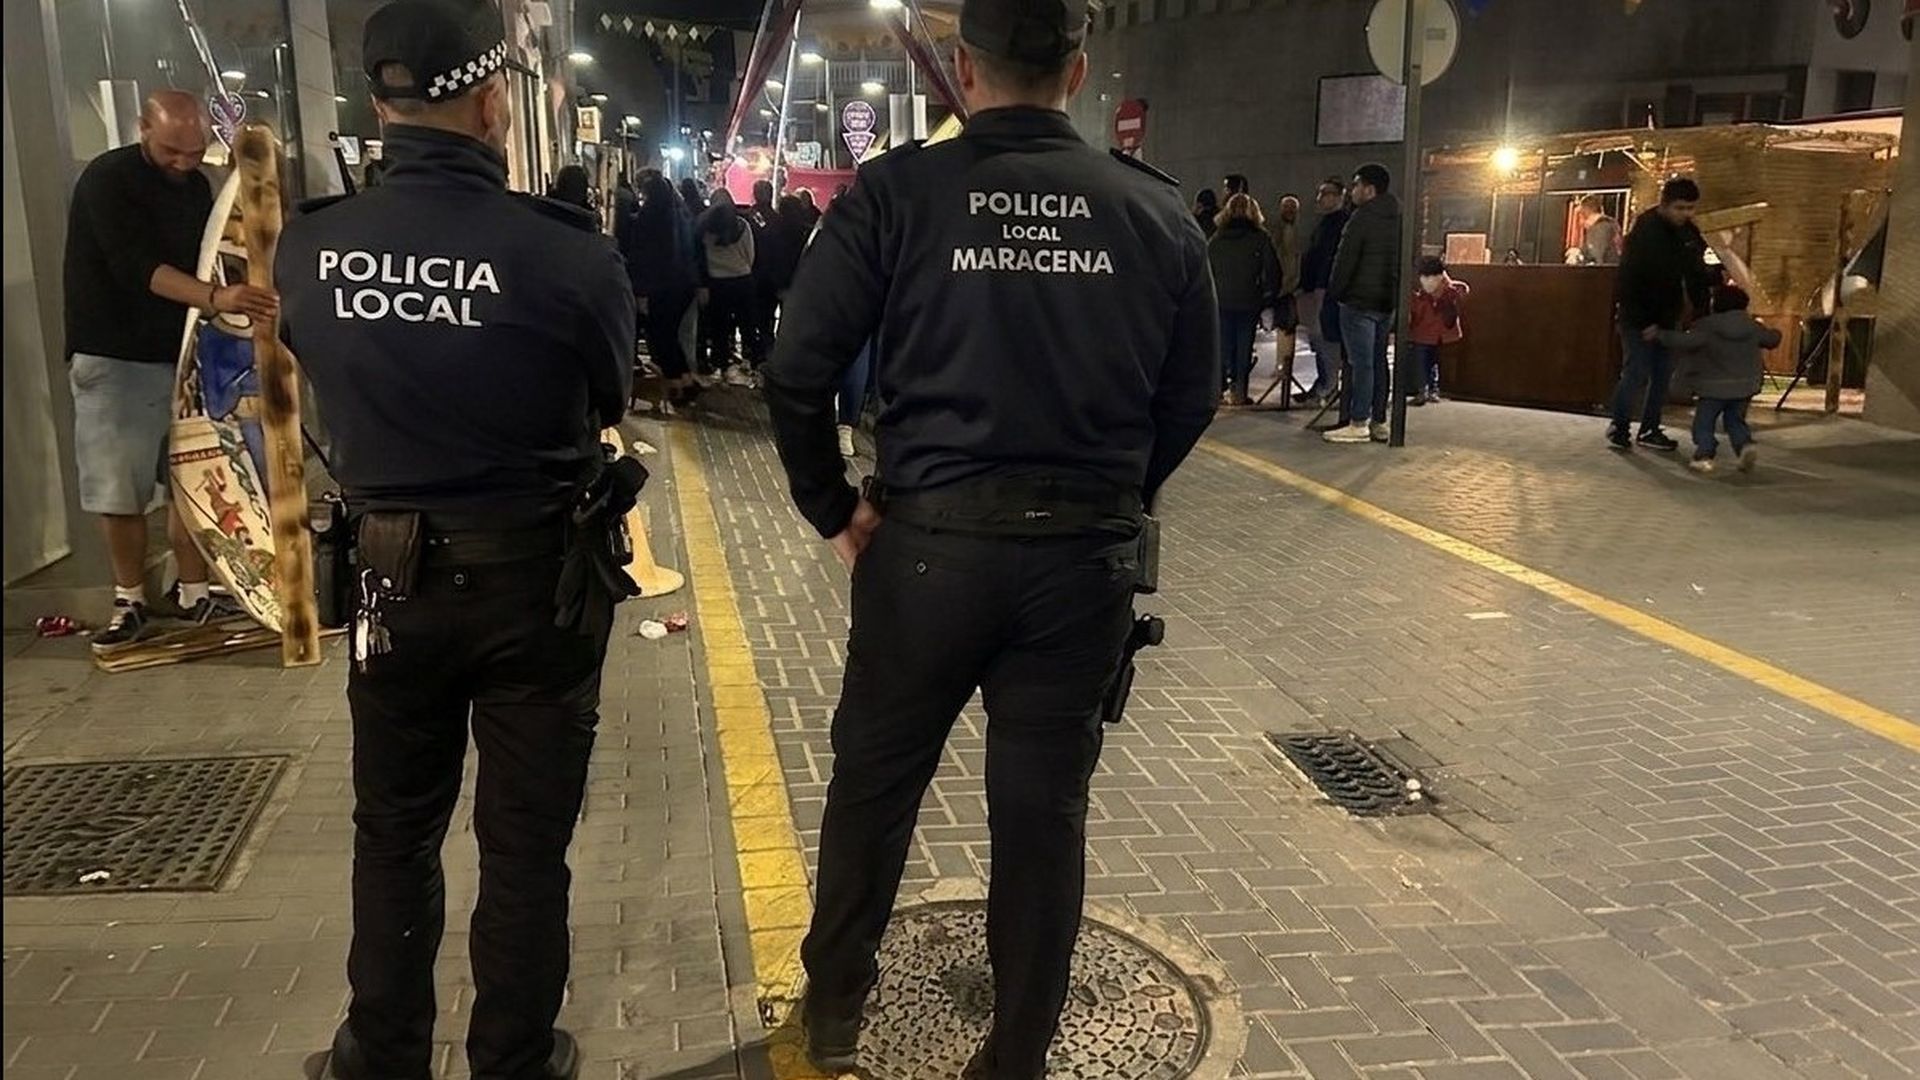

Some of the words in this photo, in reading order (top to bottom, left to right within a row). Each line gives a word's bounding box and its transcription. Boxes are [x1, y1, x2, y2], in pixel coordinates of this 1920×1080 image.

[968, 191, 1092, 218] POLICIA
[1003, 224, 1062, 241] LOCAL
[318, 250, 501, 294] POLICIA
[952, 247, 1114, 274] MARACENA
[334, 287, 483, 327] LOCAL
